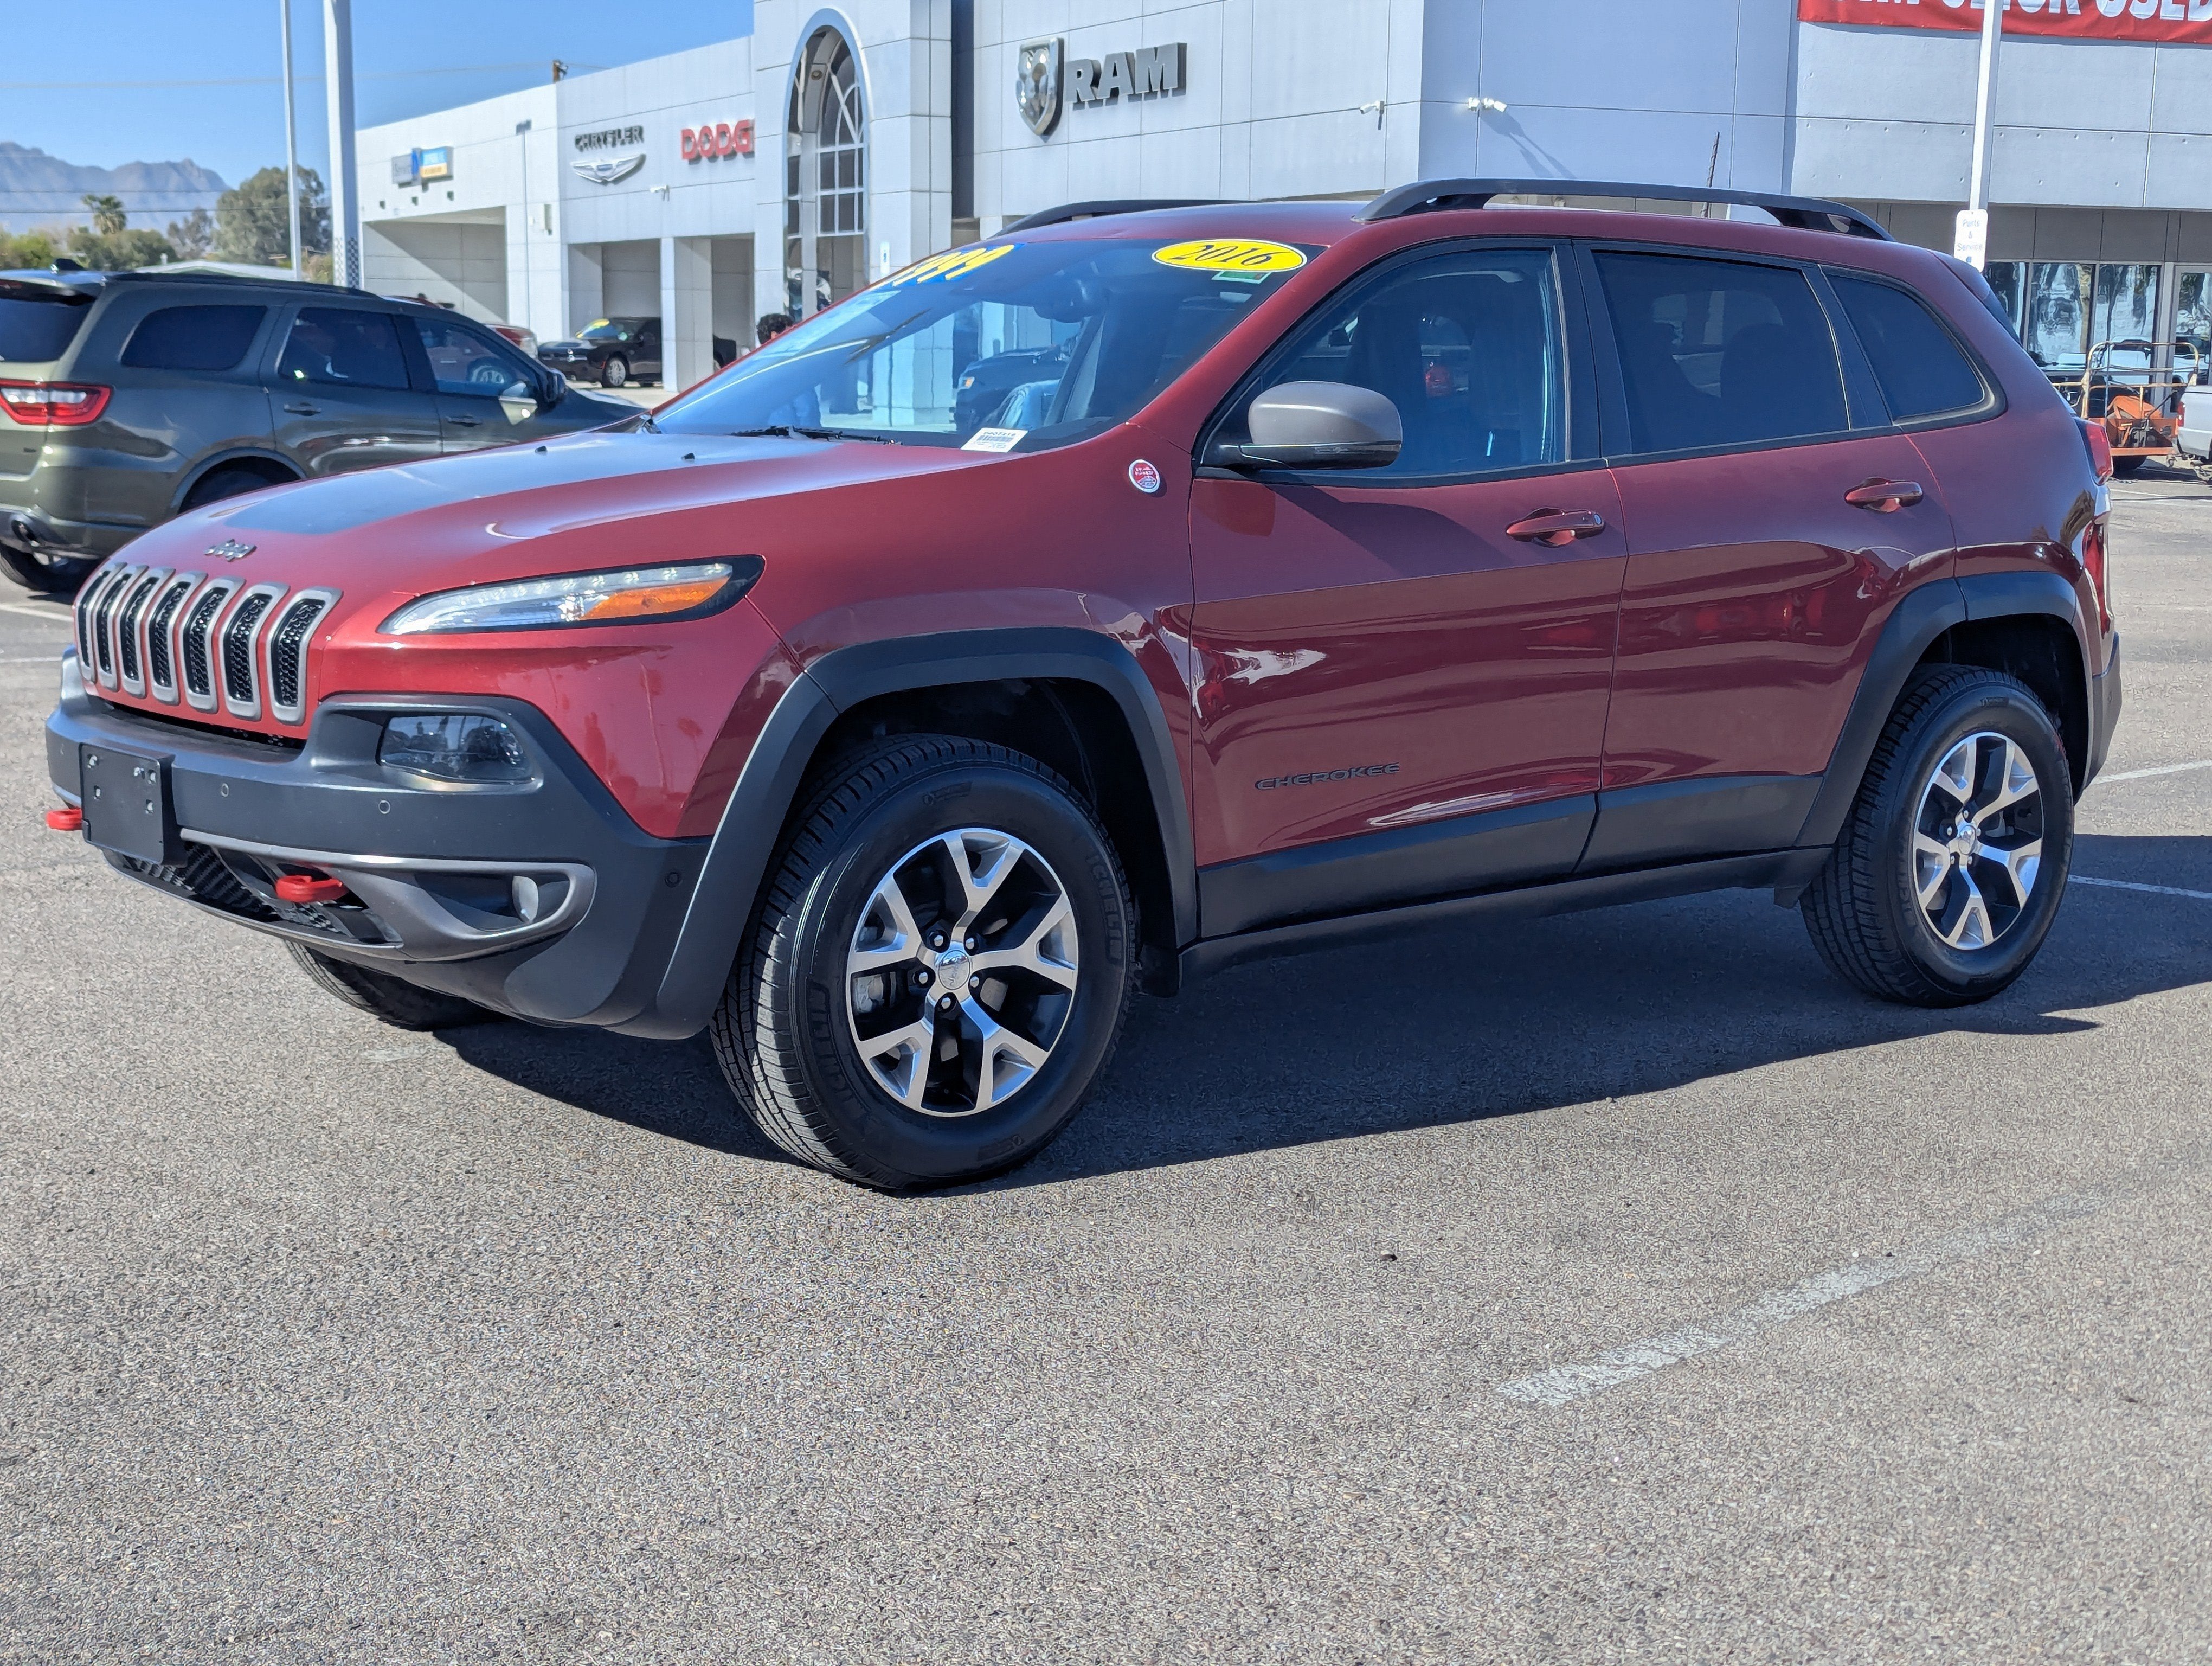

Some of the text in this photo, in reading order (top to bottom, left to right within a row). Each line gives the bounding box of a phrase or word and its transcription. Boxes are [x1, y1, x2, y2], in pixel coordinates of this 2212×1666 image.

[1065, 42, 1186, 103] RAM
[575, 125, 645, 152] CHRYSLER
[681, 119, 754, 160] DODG
[1963, 219, 1980, 227] Parts
[1167, 245, 1291, 266] 2016
[1957, 242, 1983, 251] Service
[1255, 762, 1400, 790] CHEROKEE
[1086, 853, 1122, 960] ICHELIN
